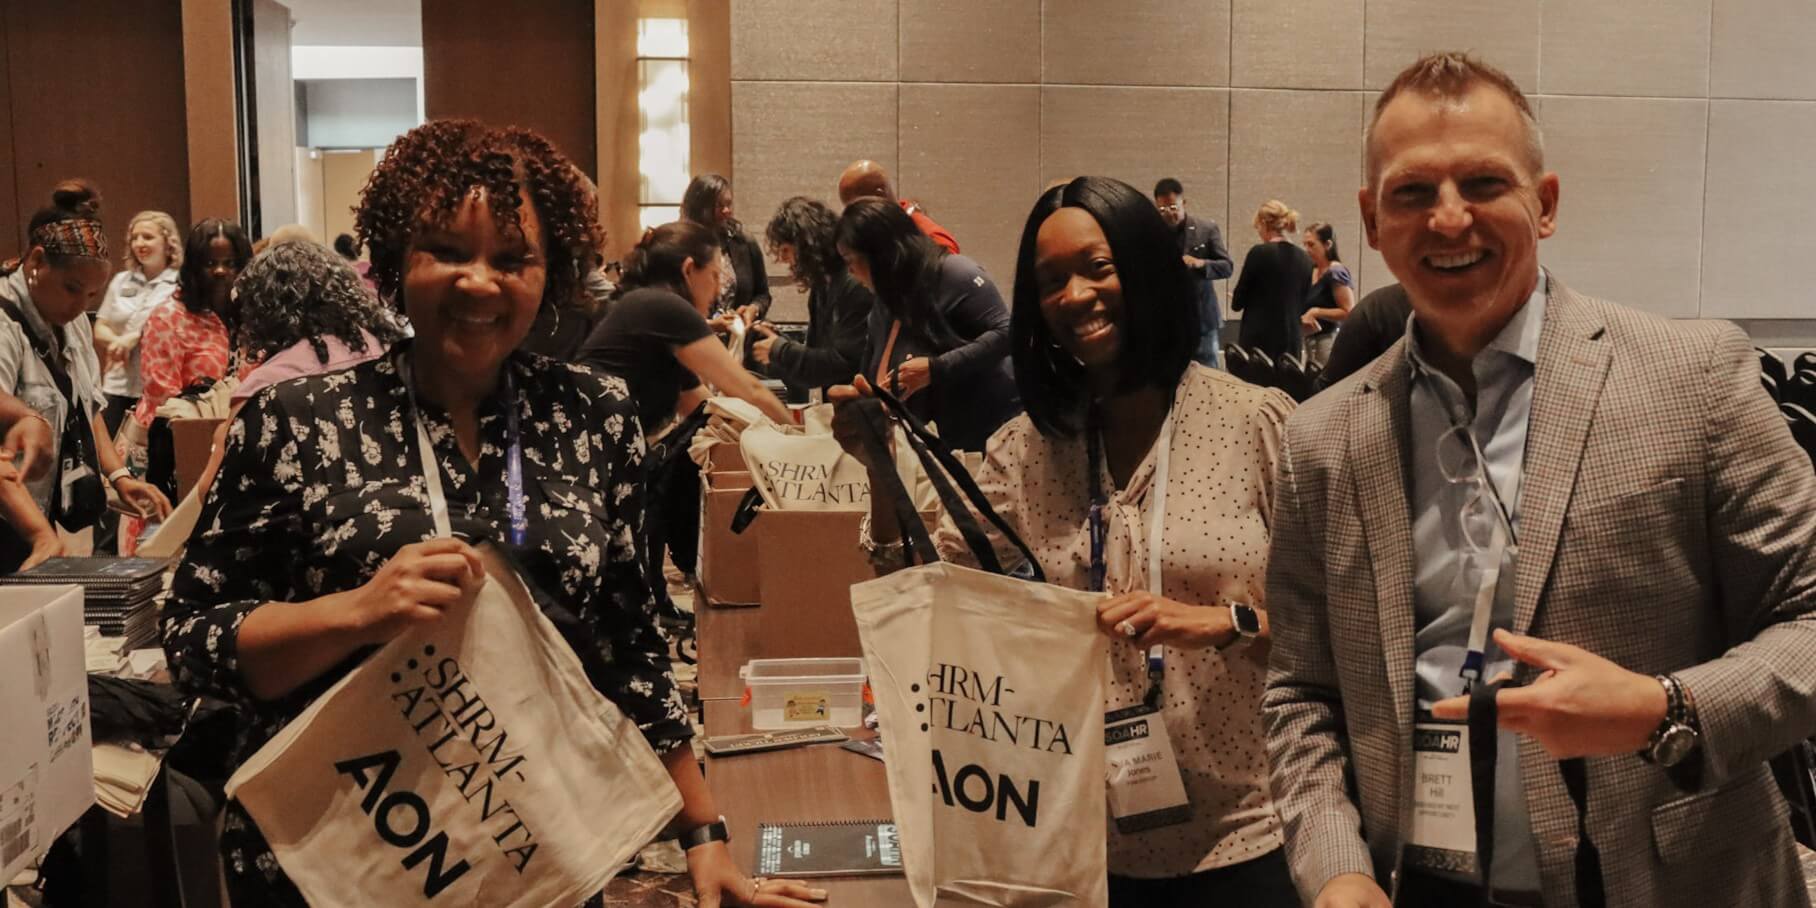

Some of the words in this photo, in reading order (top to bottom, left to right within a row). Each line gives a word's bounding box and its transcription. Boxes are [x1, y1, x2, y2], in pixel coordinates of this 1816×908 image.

[424, 657, 527, 782] SHRM-
[927, 663, 1015, 707] HRM-
[928, 697, 1073, 755] TLANTA
[334, 750, 472, 899] AON
[392, 686, 539, 874] ATLANTA
[1421, 773, 1452, 785] BRETT
